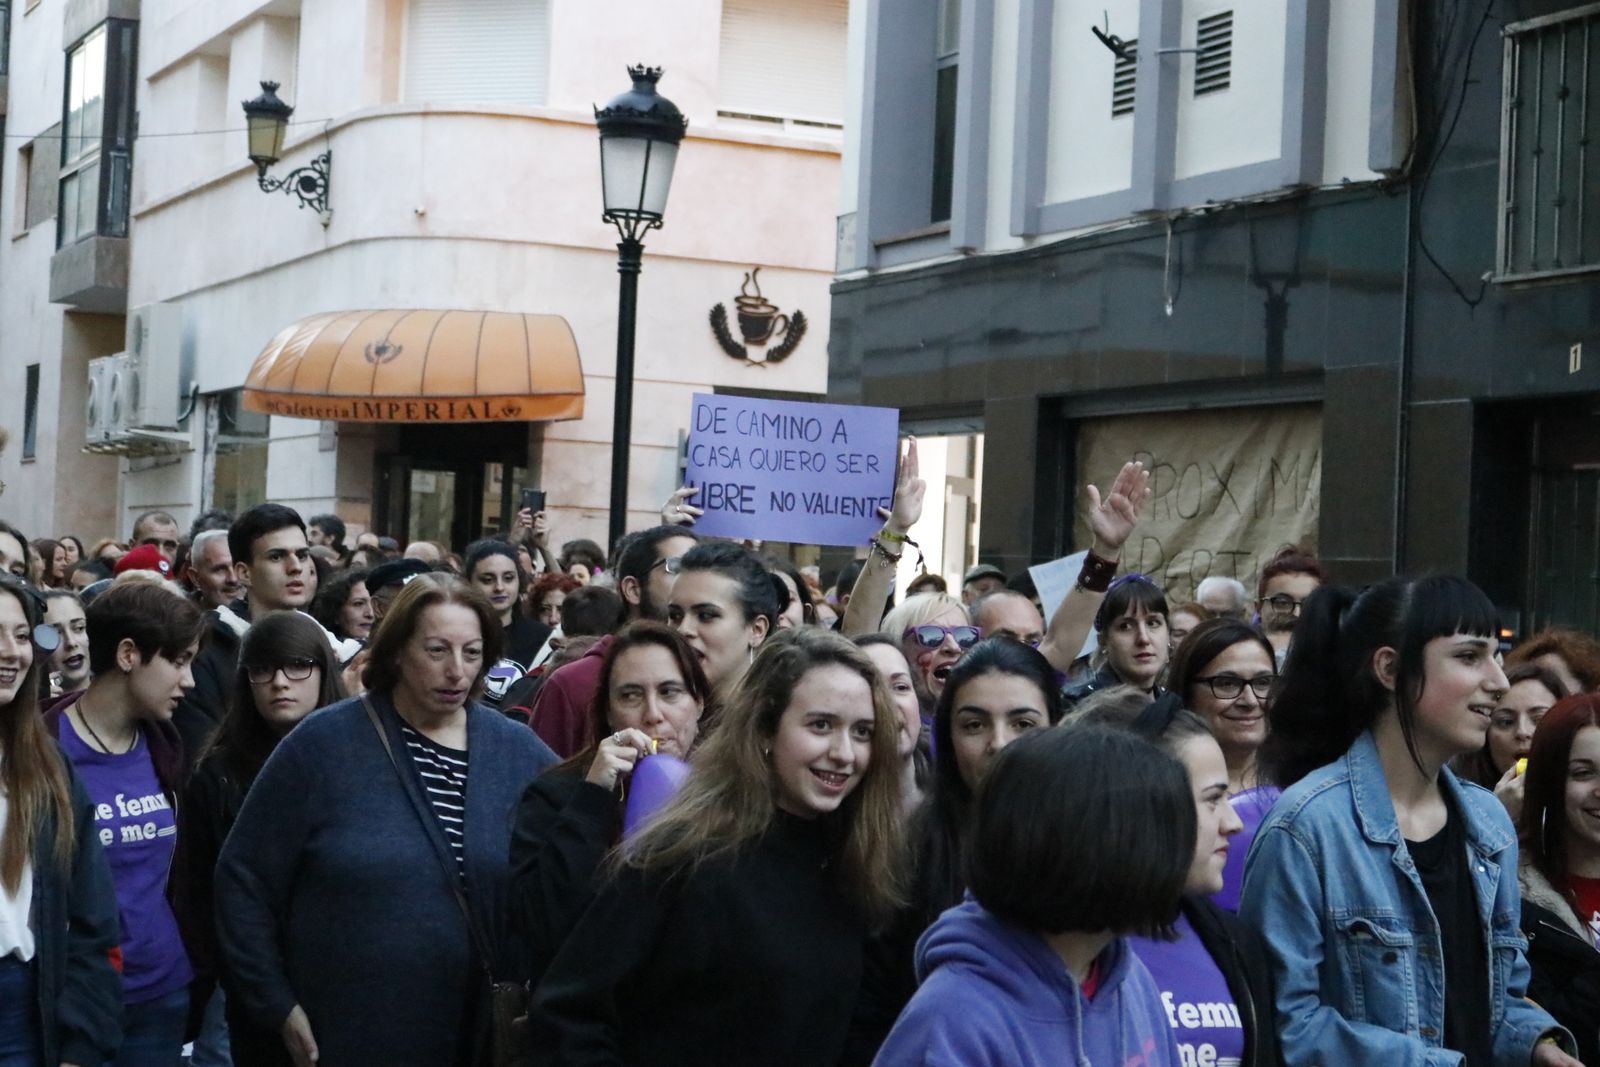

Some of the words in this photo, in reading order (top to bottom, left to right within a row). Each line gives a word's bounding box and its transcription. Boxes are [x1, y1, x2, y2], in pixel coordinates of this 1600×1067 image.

[1572, 346, 1578, 370] 1
[352, 400, 499, 420] IMPERIAL
[696, 404, 728, 434] DE
[736, 409, 822, 443] CAMINO
[831, 418, 848, 444] A
[692, 444, 741, 470] CASA
[749, 448, 827, 473] QUIERO
[836, 453, 880, 474] SER
[687, 480, 756, 514] LIBRE
[770, 490, 795, 512] NO
[94, 803, 114, 820] e
[120, 821, 157, 843] me
